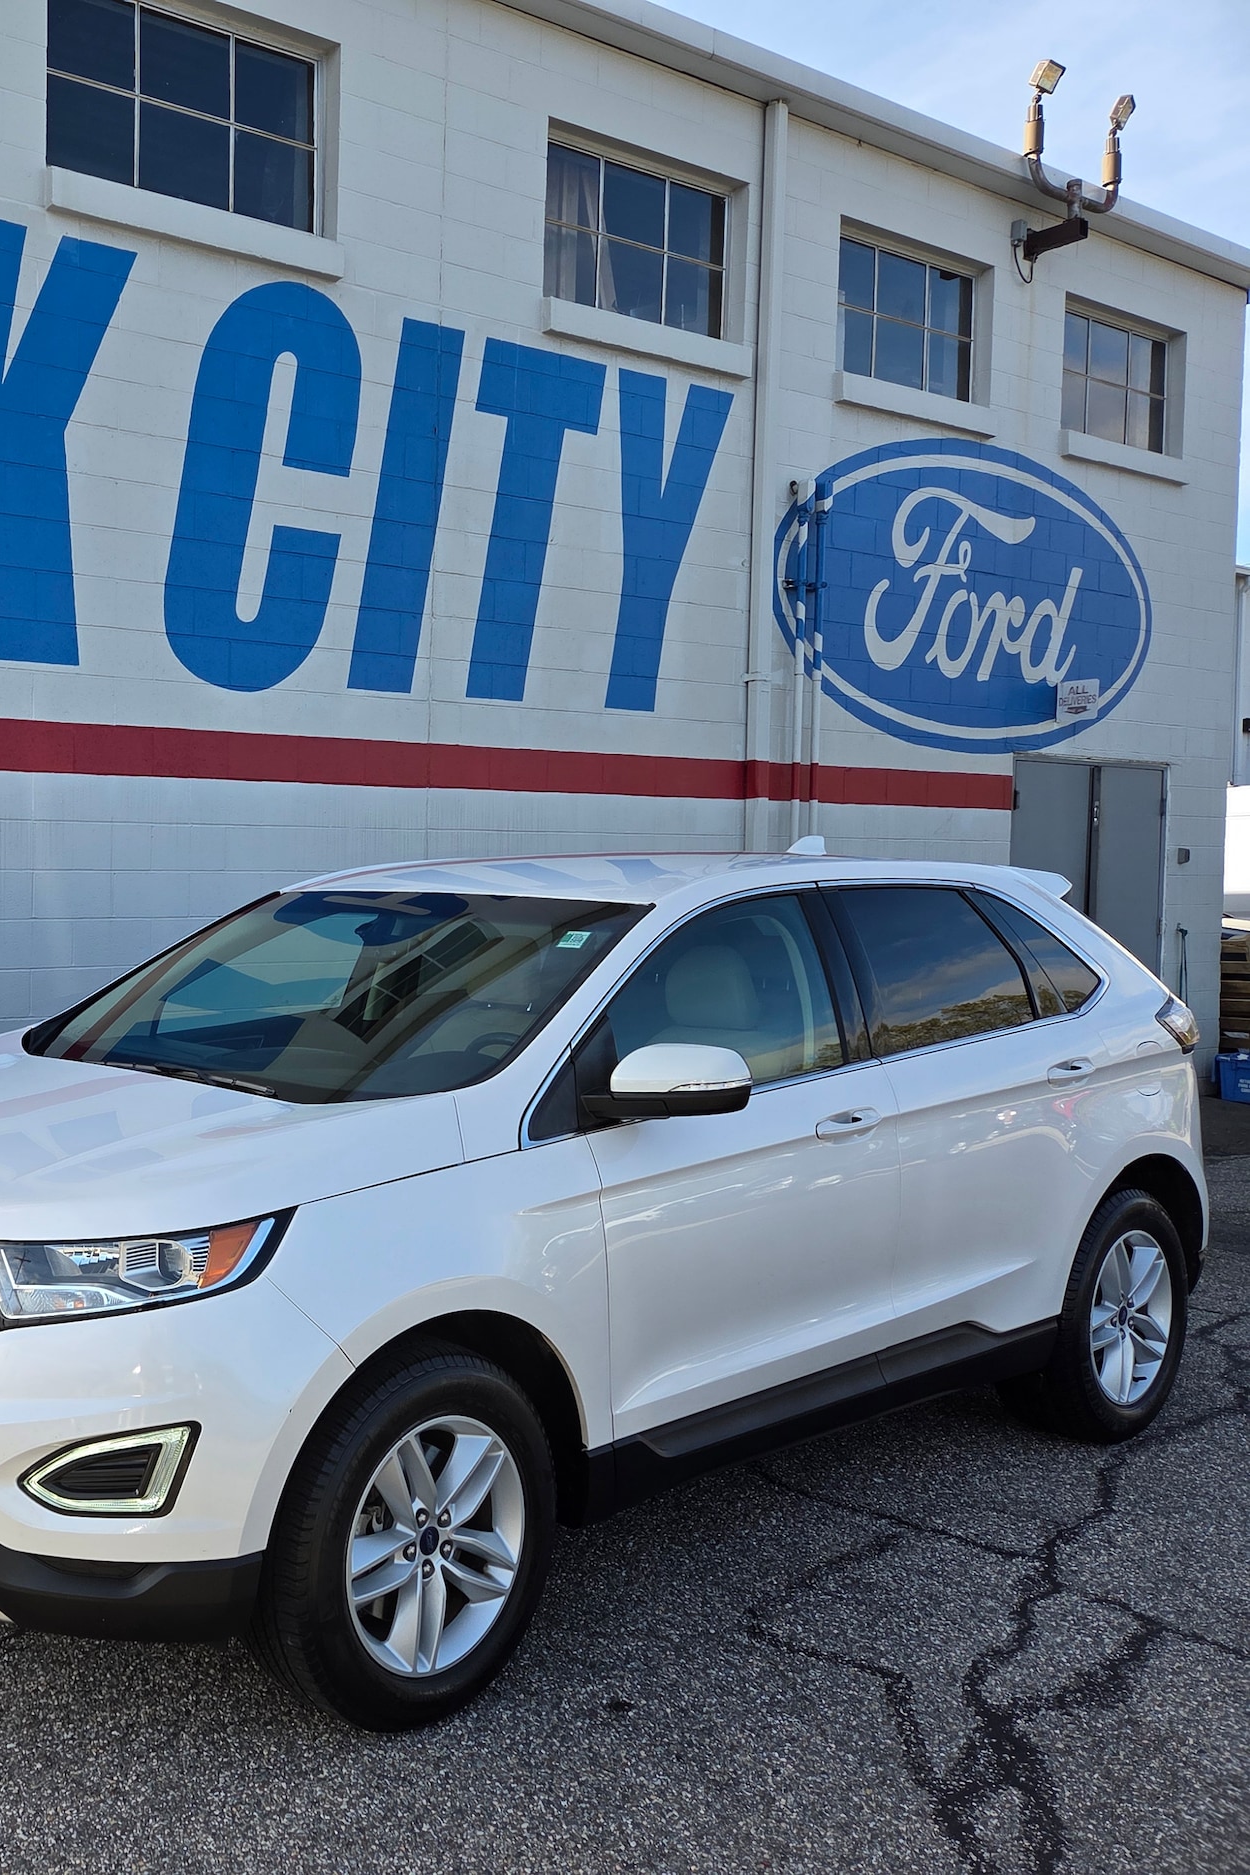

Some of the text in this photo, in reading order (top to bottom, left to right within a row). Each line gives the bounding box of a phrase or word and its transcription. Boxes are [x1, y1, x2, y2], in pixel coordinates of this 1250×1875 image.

[164, 281, 735, 712] CITY
[864, 487, 1083, 687] Ford
[1058, 694, 1097, 706] DELIVERIES
[1068, 685, 1089, 695] ALL
